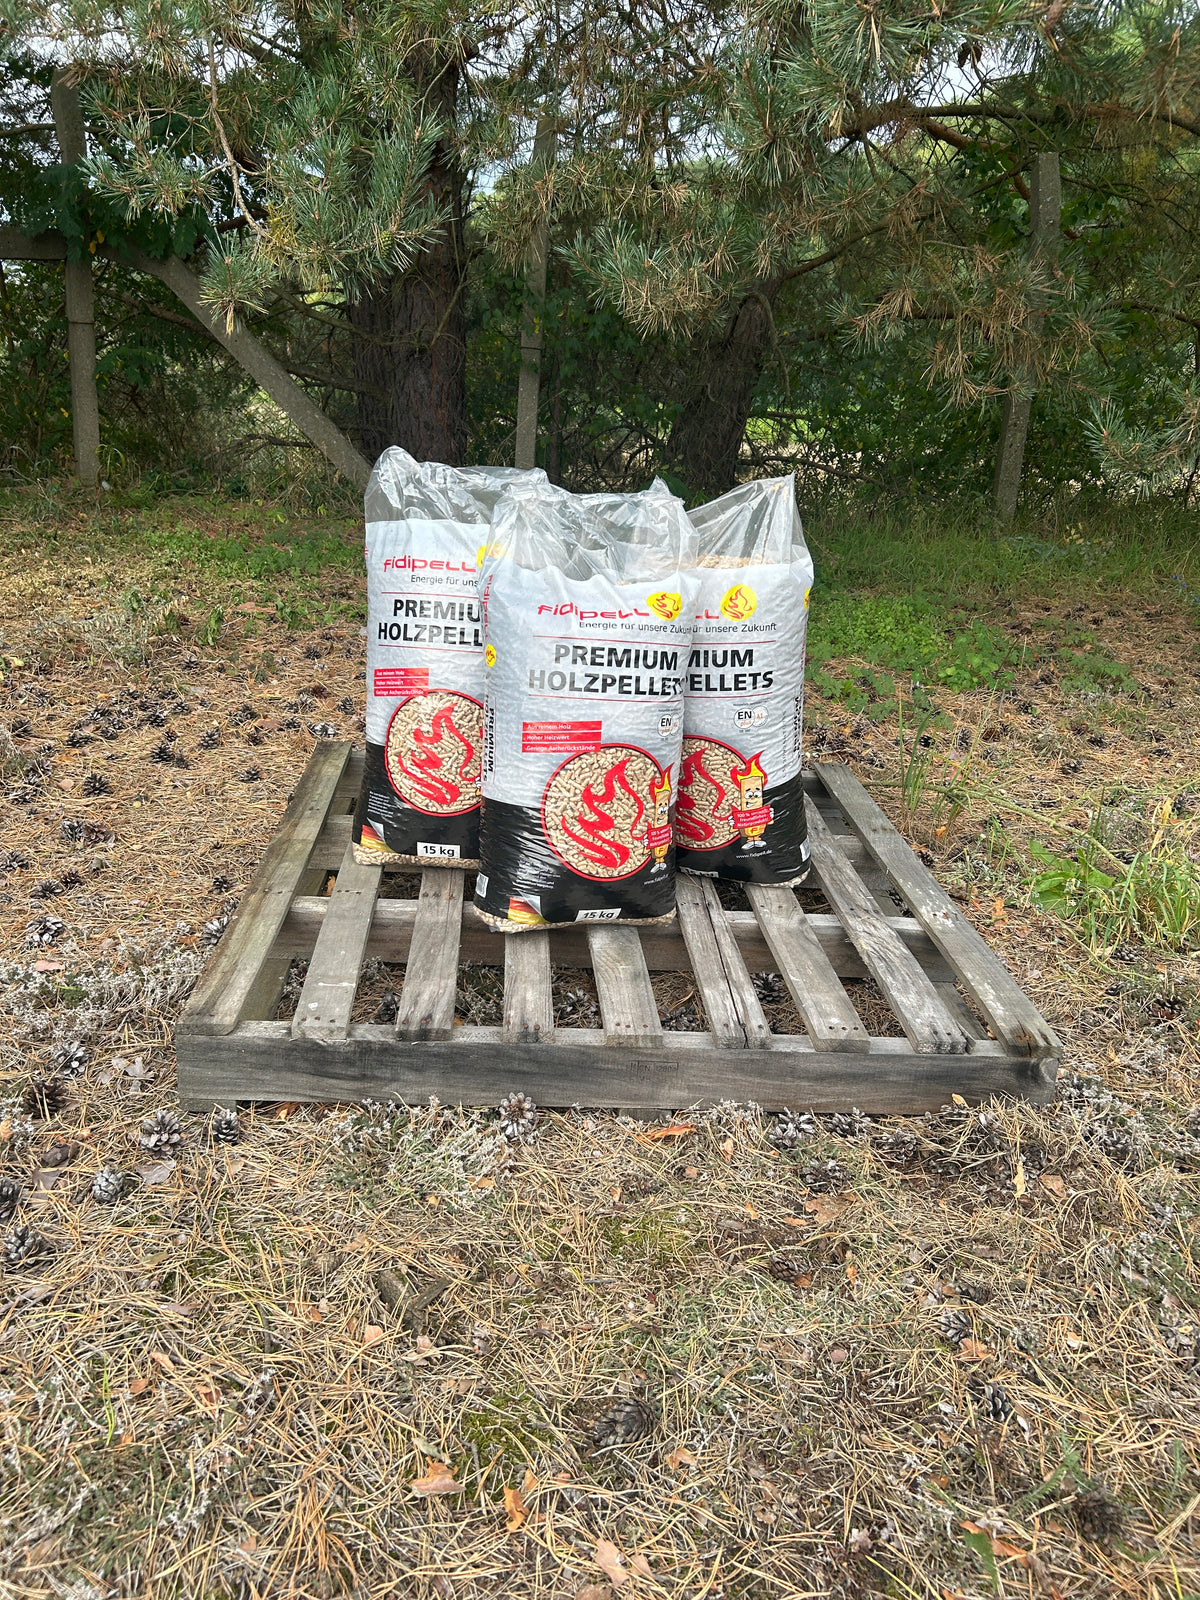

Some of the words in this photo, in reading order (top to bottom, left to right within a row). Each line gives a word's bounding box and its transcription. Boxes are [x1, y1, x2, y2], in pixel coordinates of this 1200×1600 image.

[411, 575, 443, 585] Energie
[446, 576, 459, 585] für
[462, 579, 479, 587] uns
[393, 599, 481, 622] PREMIU
[579, 622, 617, 630] Energie
[621, 622, 635, 630] für
[638, 623, 668, 633] unsere
[692, 624, 703, 633] ür
[705, 625, 738, 633] unsere
[741, 623, 777, 633] Zukunft
[378, 622, 483, 647] HOLZPELL
[554, 644, 678, 671] PREMIUM
[687, 649, 753, 668] MIUM
[689, 670, 774, 692] ELLETS
[737, 711, 752, 720] EN
[660, 717, 672, 727] EN
[423, 845, 436, 855] 15
[439, 845, 455, 857] kg
[583, 911, 598, 919] 15
